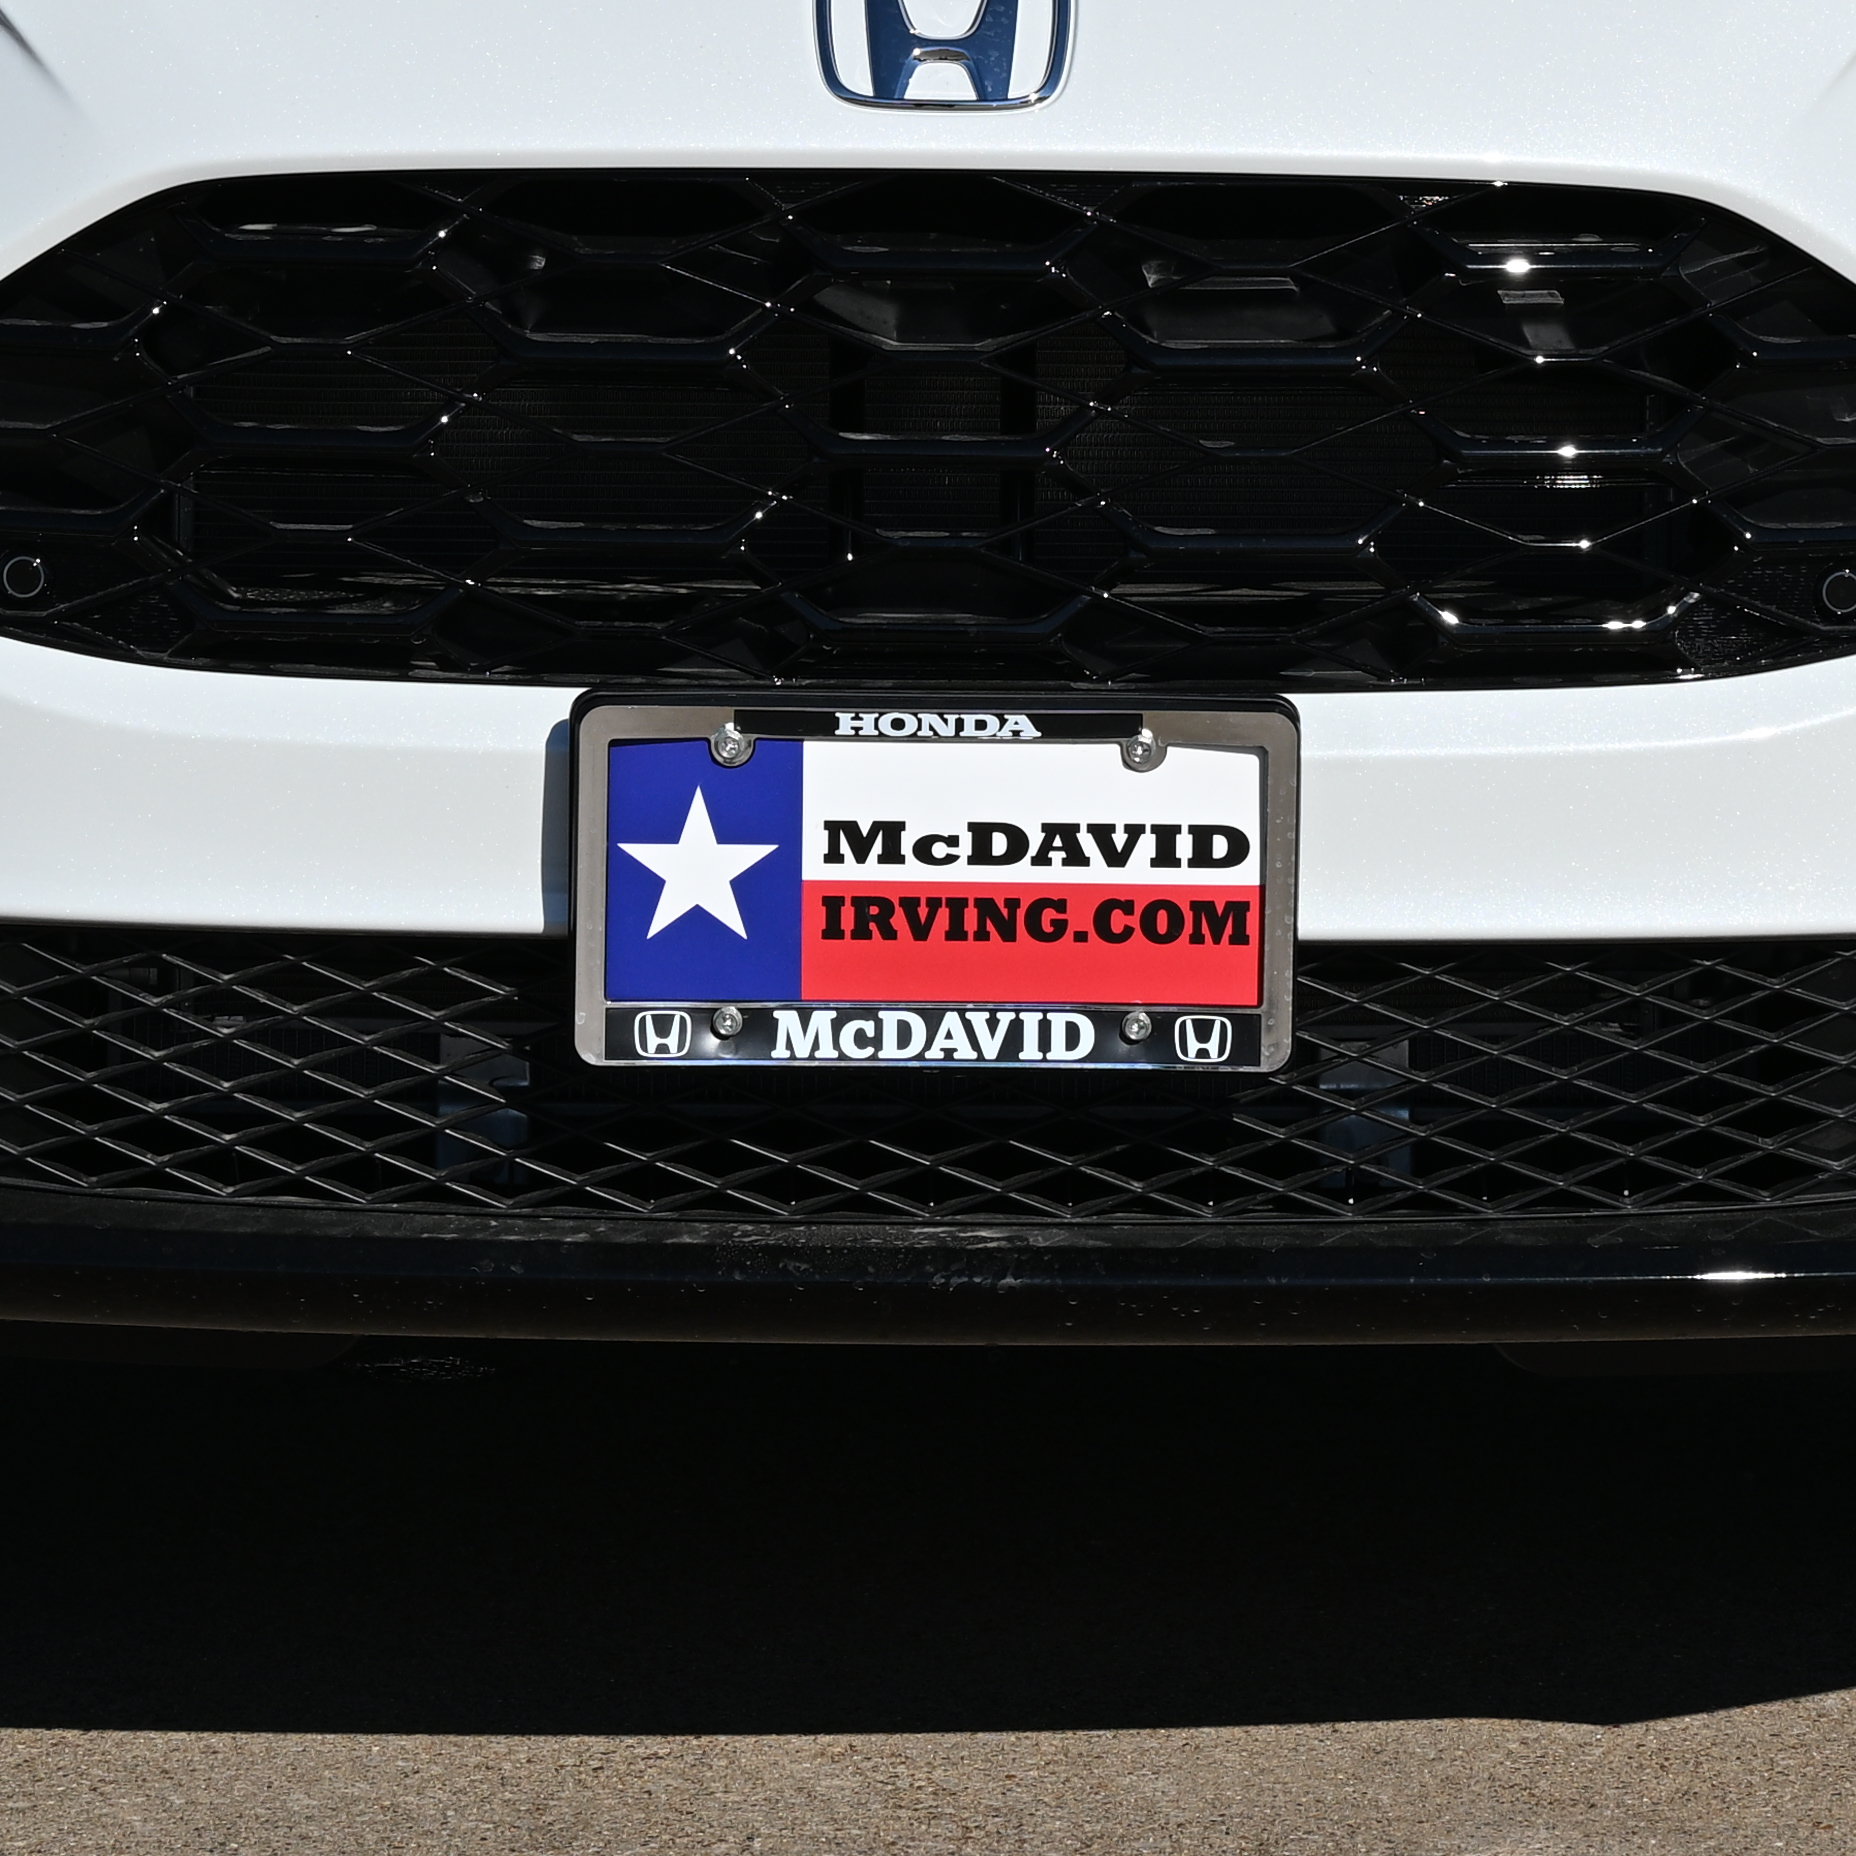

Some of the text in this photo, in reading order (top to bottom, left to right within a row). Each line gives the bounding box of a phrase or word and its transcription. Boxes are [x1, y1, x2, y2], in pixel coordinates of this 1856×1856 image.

[834, 712, 1042, 738] HONDA
[822, 820, 1251, 869] McDAVID
[821, 895, 1251, 946] IRVING.COM
[771, 1009, 1095, 1061] McDAVID
